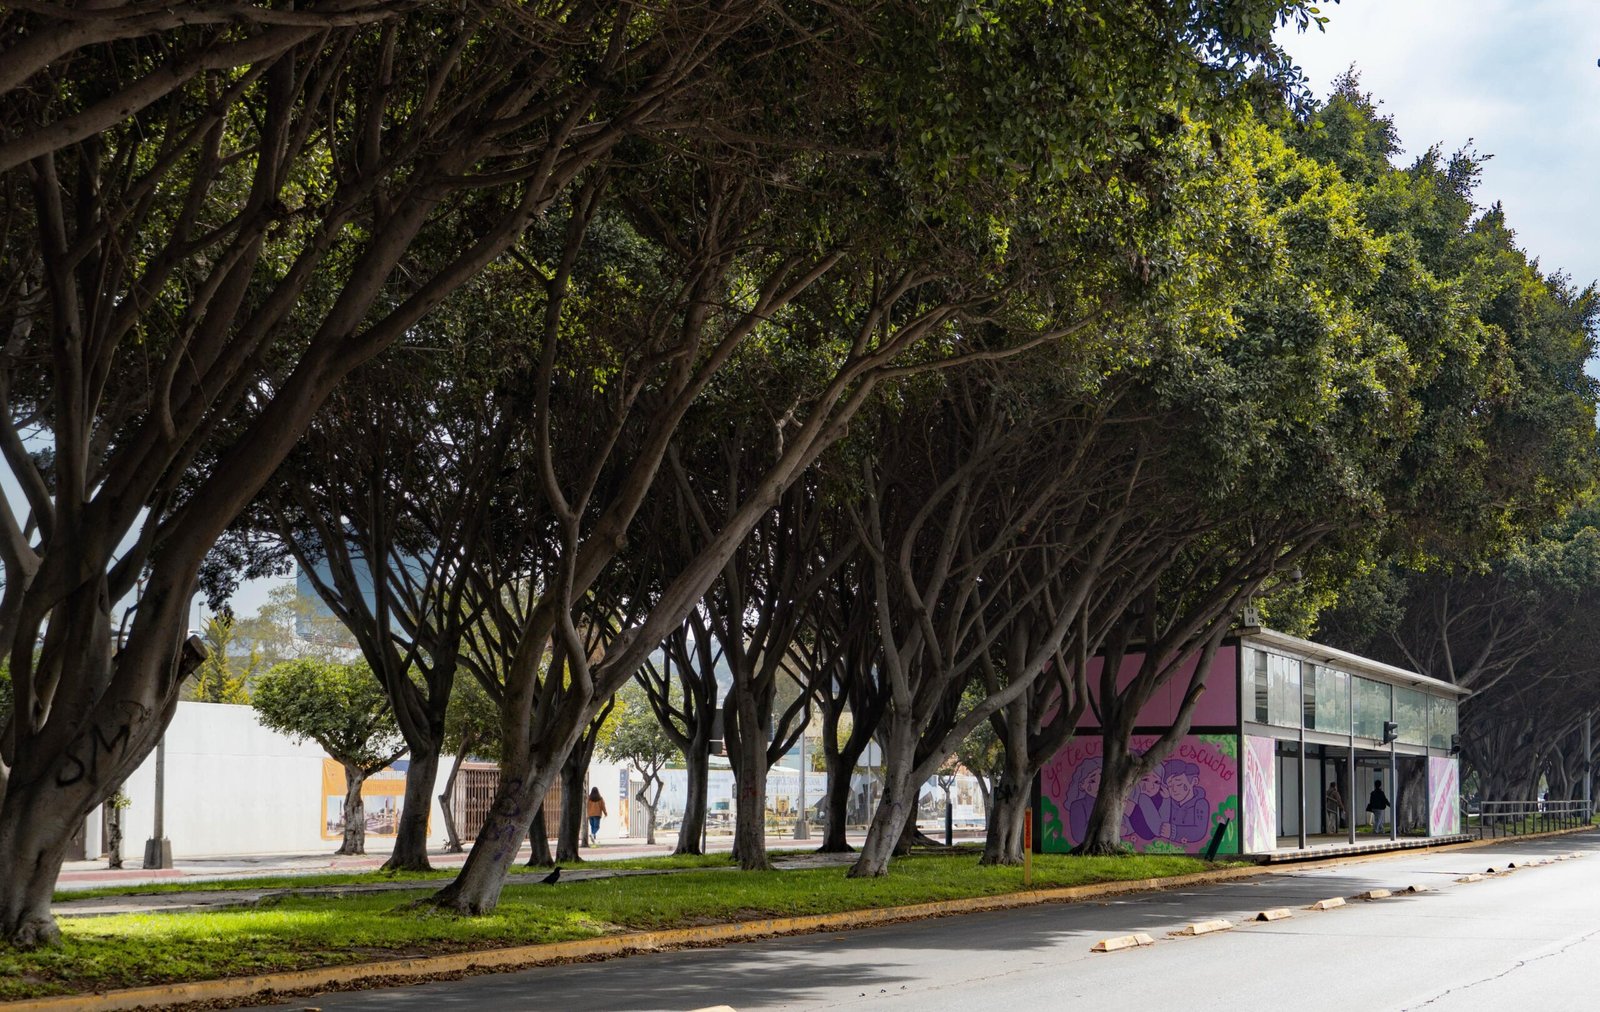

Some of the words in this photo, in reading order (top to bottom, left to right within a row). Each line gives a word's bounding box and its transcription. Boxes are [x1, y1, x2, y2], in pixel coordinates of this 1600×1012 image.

[1044, 761, 1062, 798] yo
[1061, 745, 1082, 767] te
[1085, 740, 1103, 756] cr
[1179, 744, 1235, 781] escucho
